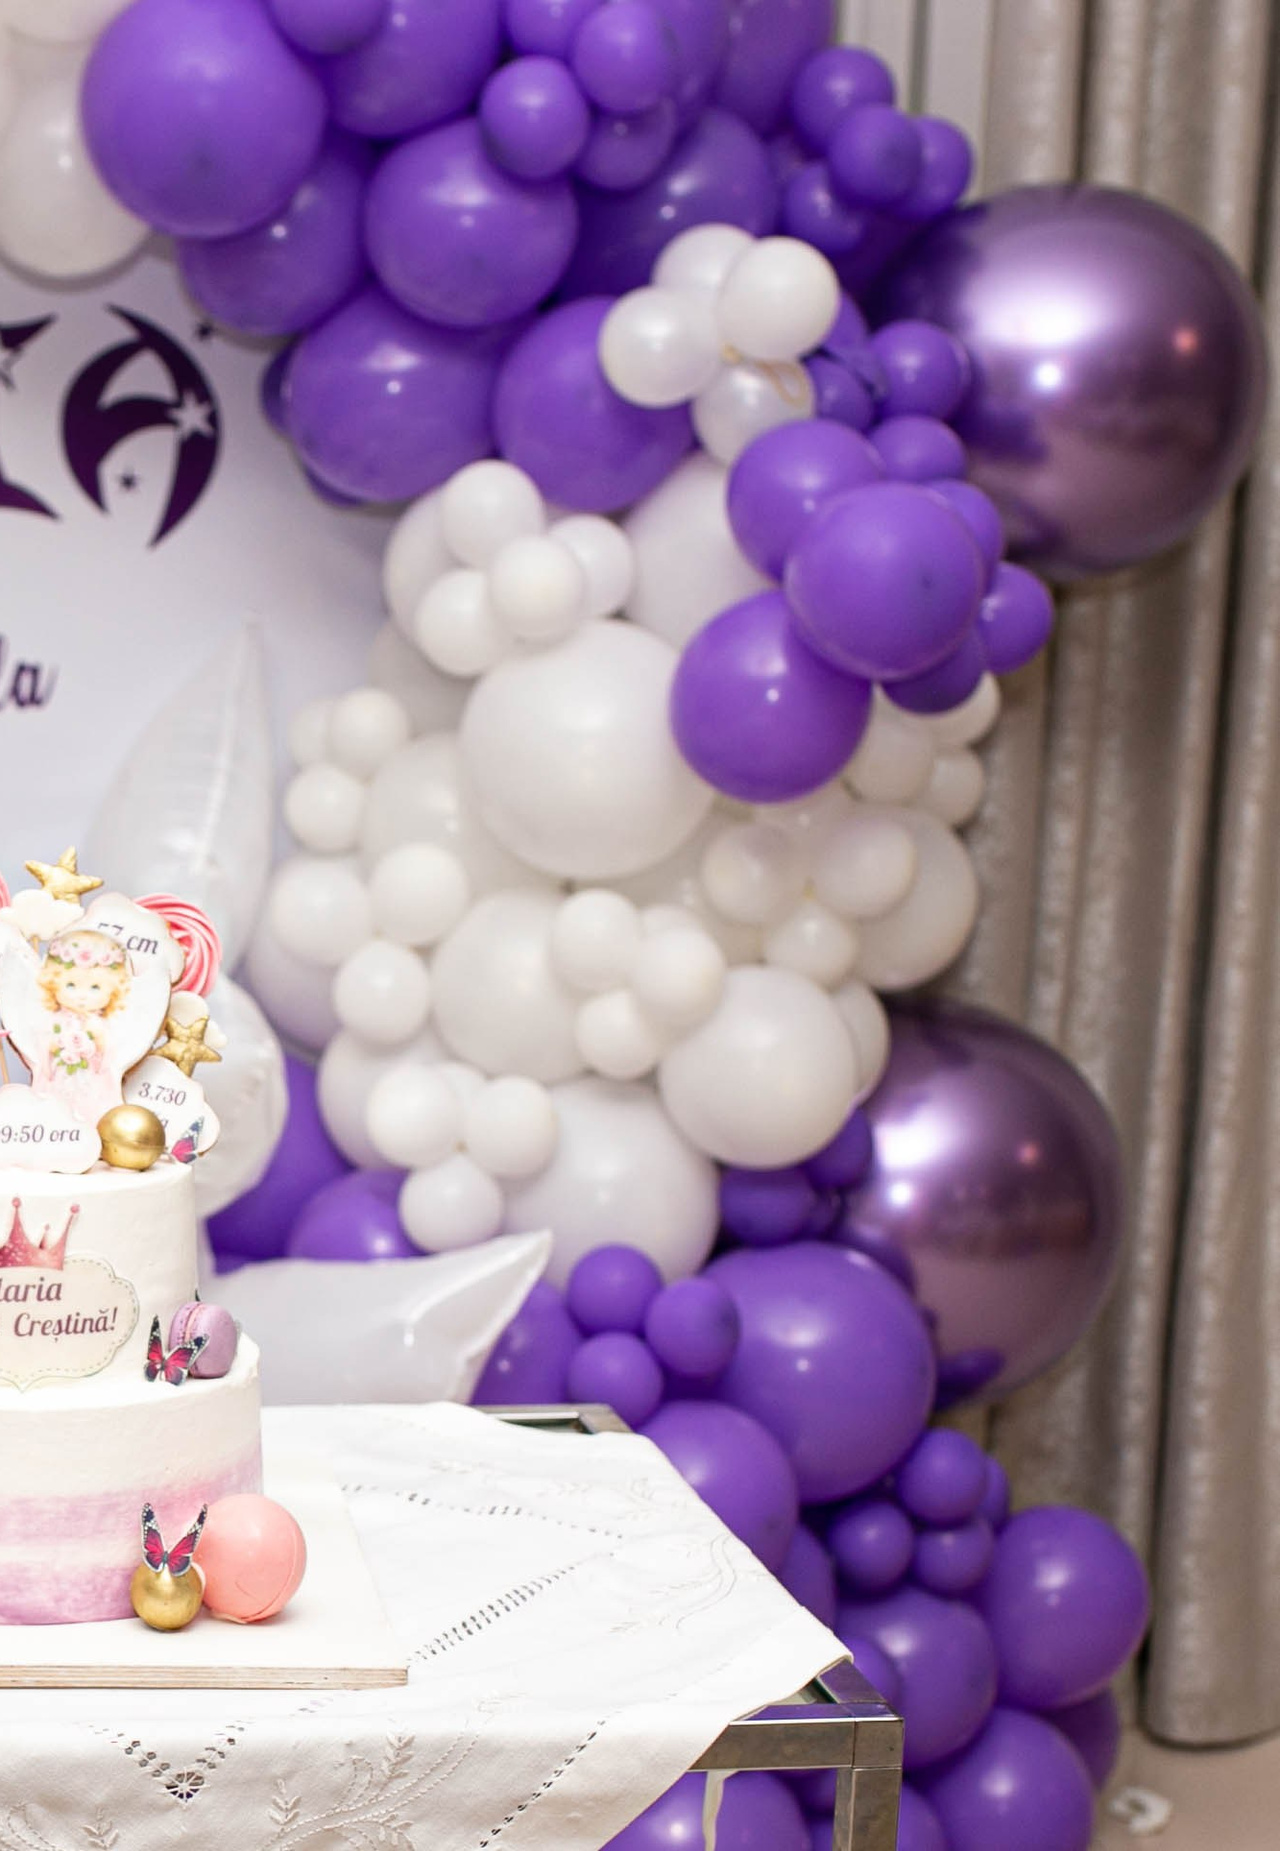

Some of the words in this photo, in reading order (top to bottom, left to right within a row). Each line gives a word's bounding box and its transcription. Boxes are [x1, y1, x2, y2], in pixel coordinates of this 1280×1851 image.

[126, 935, 158, 955] cm
[138, 1082, 186, 1106] 3.730
[49, 1129, 81, 1142] ora
